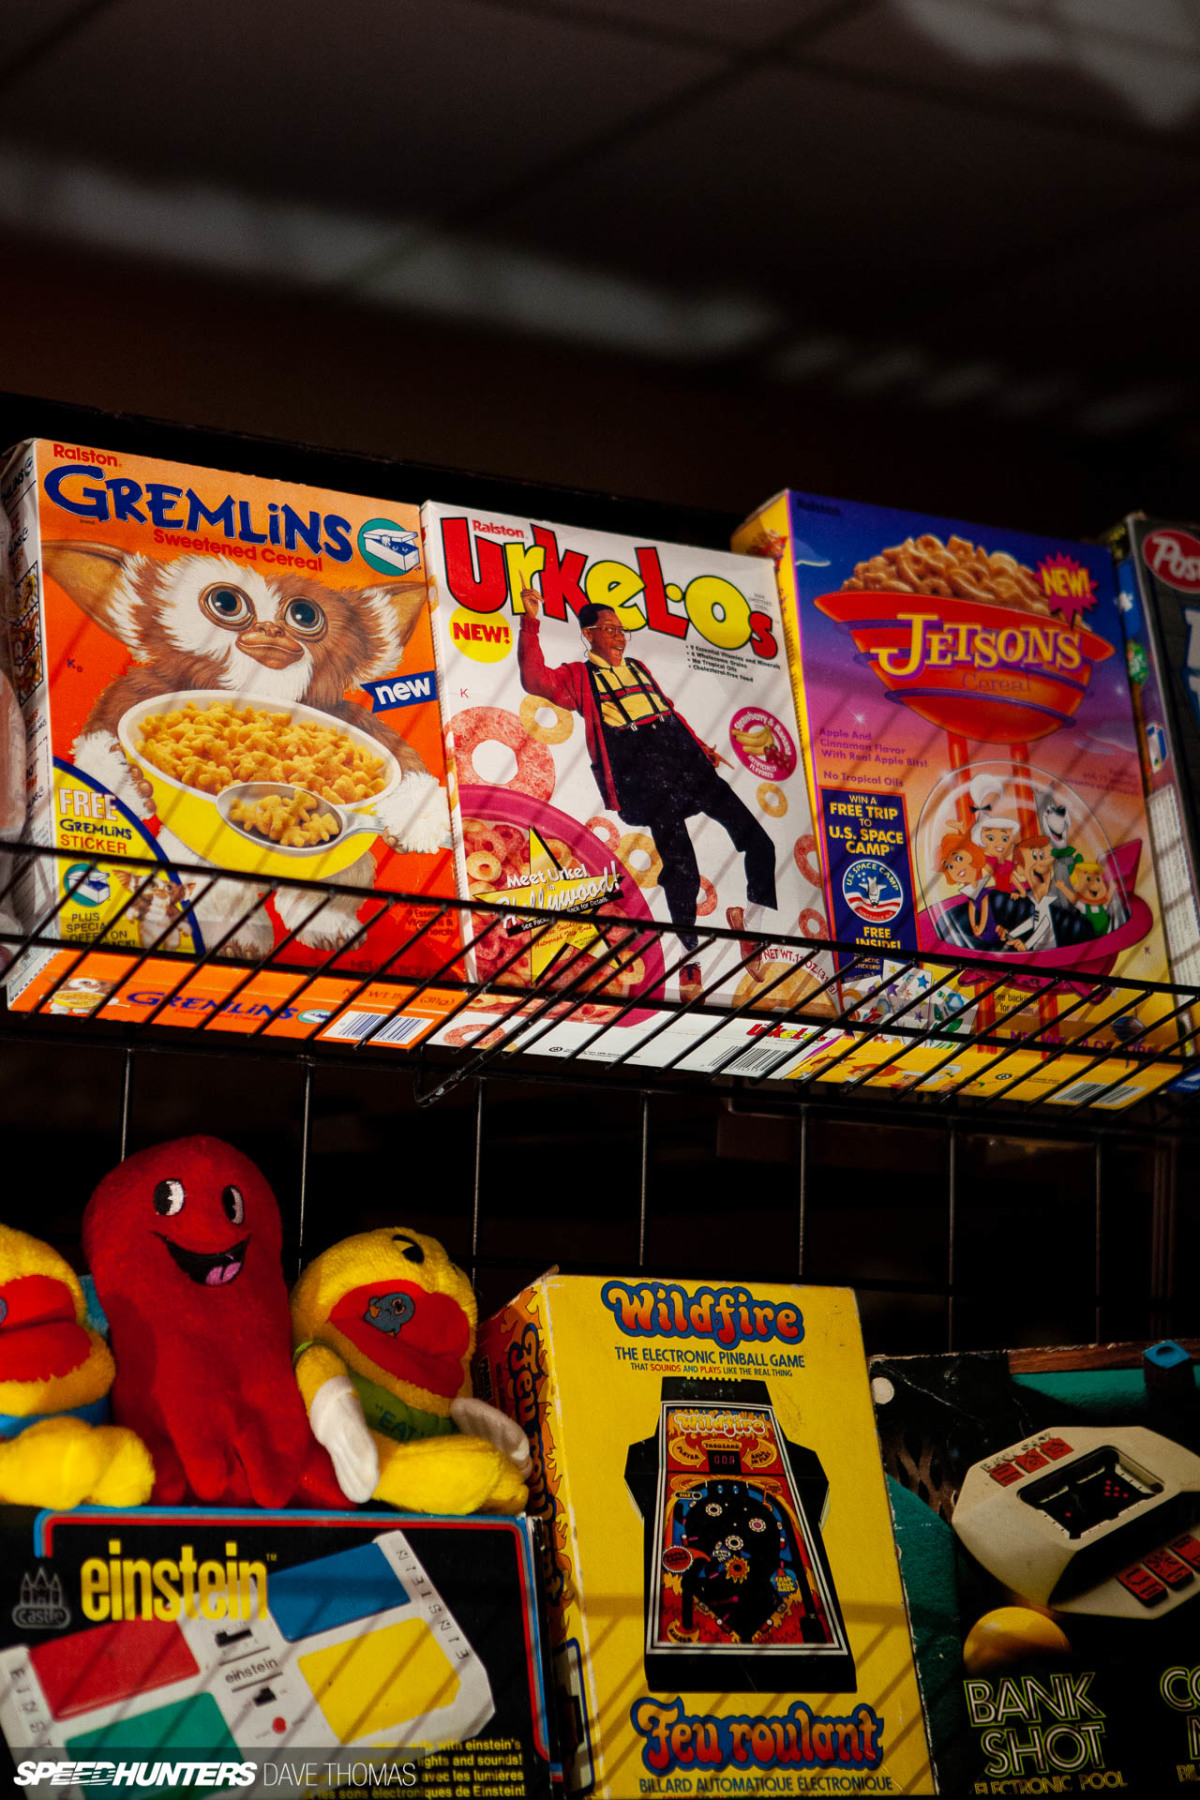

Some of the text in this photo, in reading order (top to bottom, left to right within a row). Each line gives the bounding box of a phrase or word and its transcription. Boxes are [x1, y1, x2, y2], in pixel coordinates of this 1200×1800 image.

[53, 443, 118, 467] Ralston
[472, 520, 524, 539] Ralston
[153, 528, 323, 571] Sweetened Cereal
[1041, 567, 1091, 598] NEW!
[453, 622, 510, 645] NEW!
[375, 677, 431, 705] new
[962, 672, 1032, 692] Cereal
[460, 688, 469, 698] K
[820, 727, 872, 740] Apple And
[820, 739, 906, 754] Cinnamon Flavor
[821, 749, 846, 759] With
[849, 752, 872, 762] Real
[874, 755, 904, 765] Apple
[824, 771, 904, 787] No Tropical Oils
[59, 788, 118, 821] FREE
[849, 795, 877, 805] WIN A
[829, 802, 898, 820] FREE TRIP
[859, 818, 872, 827] TO
[60, 834, 127, 854] STICKER
[829, 826, 904, 844] U.S. SPACE
[507, 864, 589, 888] Meet Urkel
[853, 862, 877, 874] SPACE
[879, 867, 899, 891] CAMP
[72, 913, 100, 922] PLUS
[110, 931, 127, 940] ON
[863, 926, 891, 939] FREE
[763, 948, 779, 960] NET
[603, 1282, 803, 1348] Wildfire
[615, 1347, 805, 1368] THE ELECTRONIC PINBALL GAME
[631, 1363, 793, 1377] THAT SOUNDS AND PLAYS LIKE THE REAL THING
[674, 1414, 766, 1437] Wildfire
[80, 1538, 268, 1622] einstein
[225, 1658, 279, 1684] einstein
[962, 1671, 1107, 1728] BANK
[439, 1738, 522, 1751] with einstein's
[635, 1699, 881, 1771] Feu roulant
[980, 1721, 1107, 1778] SHOT
[453, 1754, 474, 1766] and
[476, 1753, 523, 1766] sounds!
[421, 1768, 525, 1782] avec les lumières
[639, 1776, 893, 1793] BILLARD AUTOMATIQUE ELECTRONIQUE
[1078, 1771, 1129, 1792] POOL
[339, 1789, 369, 1799] sons
[455, 1785, 470, 1797] de
[473, 1784, 526, 1797] Einstein!
